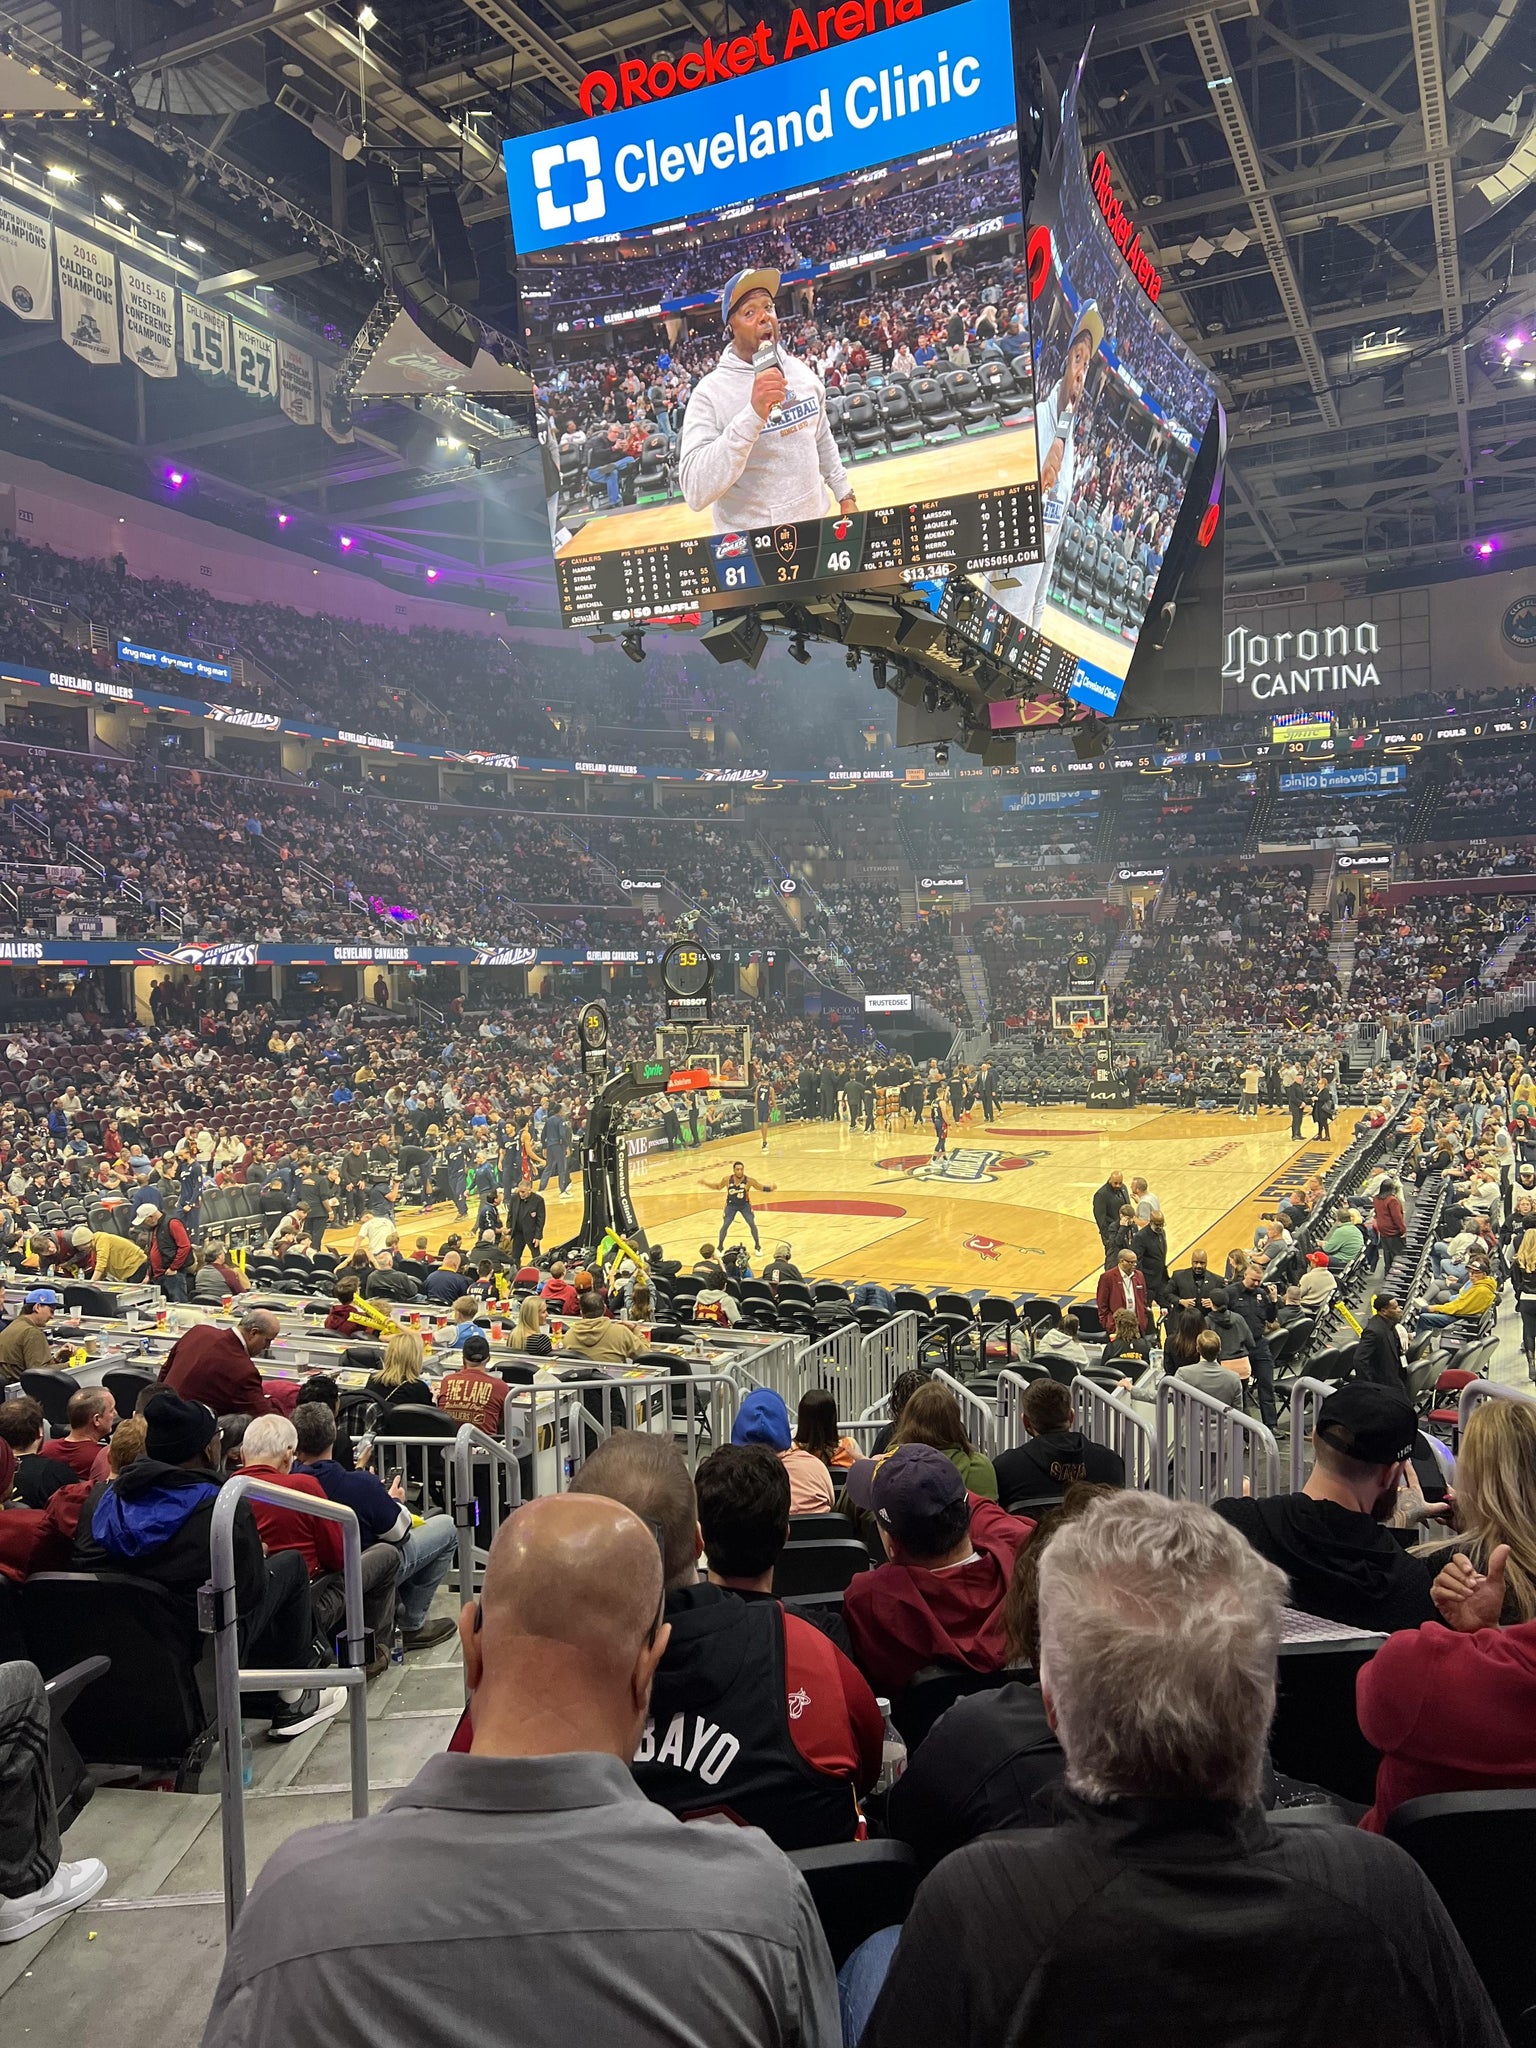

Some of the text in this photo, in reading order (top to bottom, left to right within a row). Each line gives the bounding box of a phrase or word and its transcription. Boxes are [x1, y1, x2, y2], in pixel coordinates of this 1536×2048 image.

[621, 0, 923, 106] Rocket Arena
[614, 50, 981, 192] Cleveland Clinic
[16, 213, 43, 236] DIVISION
[1096, 164, 1162, 303] Rocket Arena
[73, 244, 97, 265] 2016
[60, 255, 113, 288] CALDER CUP
[61, 271, 113, 305] CHAMPIONS
[128, 275, 166, 303] 2015-16
[131, 292, 167, 319] WESTERN
[126, 304, 173, 335] CONFERENCE
[187, 304, 225, 331] CALLANDER
[128, 320, 172, 348] CHAMPIONS
[192, 321, 222, 369] 15
[240, 346, 271, 392] 27
[922, 501, 939, 510] HEAT
[1008, 487, 1020, 495] AST
[875, 508, 895, 518] FOULS
[923, 509, 952, 521] LARSSON
[754, 535, 771, 548] 3Q
[892, 538, 901, 546] 40
[924, 529, 955, 540] ADEBAYO
[680, 540, 699, 548] FOULS
[780, 542, 794, 552] +35
[925, 541, 948, 550] HERRO
[571, 555, 602, 565] CAVALIERS
[827, 550, 851, 571] 46
[925, 550, 957, 560] MITCHELL
[572, 565, 596, 574] HARDEN
[700, 567, 709, 575] 55
[777, 565, 800, 582] 3.7
[903, 549, 1039, 583] $13,346 CAVS5050.COM
[573, 574, 592, 583] STRUS
[725, 565, 747, 586] 81
[574, 583, 597, 592] MOBLEY
[575, 593, 593, 601] ALLEN
[576, 601, 604, 609] MITCHELL
[571, 610, 600, 624] oswald
[654, 600, 700, 617] RAFFLE
[1008, 647, 1018, 663] 46
[1221, 620, 1382, 683] Corona
[122, 647, 139, 659] drug
[139, 651, 157, 661] mart
[176, 660, 193, 669] mart
[196, 663, 212, 675] drug
[212, 667, 228, 678] mart
[49, 672, 134, 700] CLEVELAND CAVALIERS
[1251, 662, 1381, 699] CANTINA
[1083, 677, 1118, 702] Cleveland Clinic
[338, 730, 395, 750] CLEVELAND CAVALIERS
[1283, 728, 1320, 740] Sprite
[1068, 762, 1094, 771] FOULS
[1115, 760, 1133, 768] FG%
[1138, 758, 1150, 766] 55
[1194, 751, 1206, 761] 81
[1257, 747, 1270, 755] 3.7
[1288, 742, 1304, 753] 3Q
[1320, 740, 1334, 750] 46
[1385, 735, 1406, 743] FG%
[1410, 732, 1424, 742] 40
[1437, 727, 1467, 739] FOULS
[1473, 725, 1481, 736] 0
[1493, 722, 1514, 732] TOL
[1519, 720, 1527, 731] 3
[575, 762, 638, 775] CLEVELAND CAVALIERS
[829, 770, 861, 780] CLEVELAND
[862, 770, 894, 780] CAVALIERS
[1352, 855, 1390, 865] LEXUS
[1130, 869, 1164, 877] LEXUS
[632, 880, 662, 889] LEXUS
[78, 922, 96, 931] WTAM
[0, 943, 43, 959] VALIERS
[333, 947, 409, 960] CLEVELAND CAVALIERS
[586, 950, 609, 961] CLEVELAND
[610, 950, 639, 961] CAVALIERS
[679, 952, 697, 967] 35
[1076, 956, 1089, 965] 35
[680, 998, 707, 1007] TISSOT
[588, 1015, 599, 1028] 35
[643, 1063, 664, 1080] Sprite
[618, 1151, 633, 1225] Cleveland Clinic
[446, 1379, 493, 1405] THE LAND
[633, 1712, 740, 1785] BAYO
